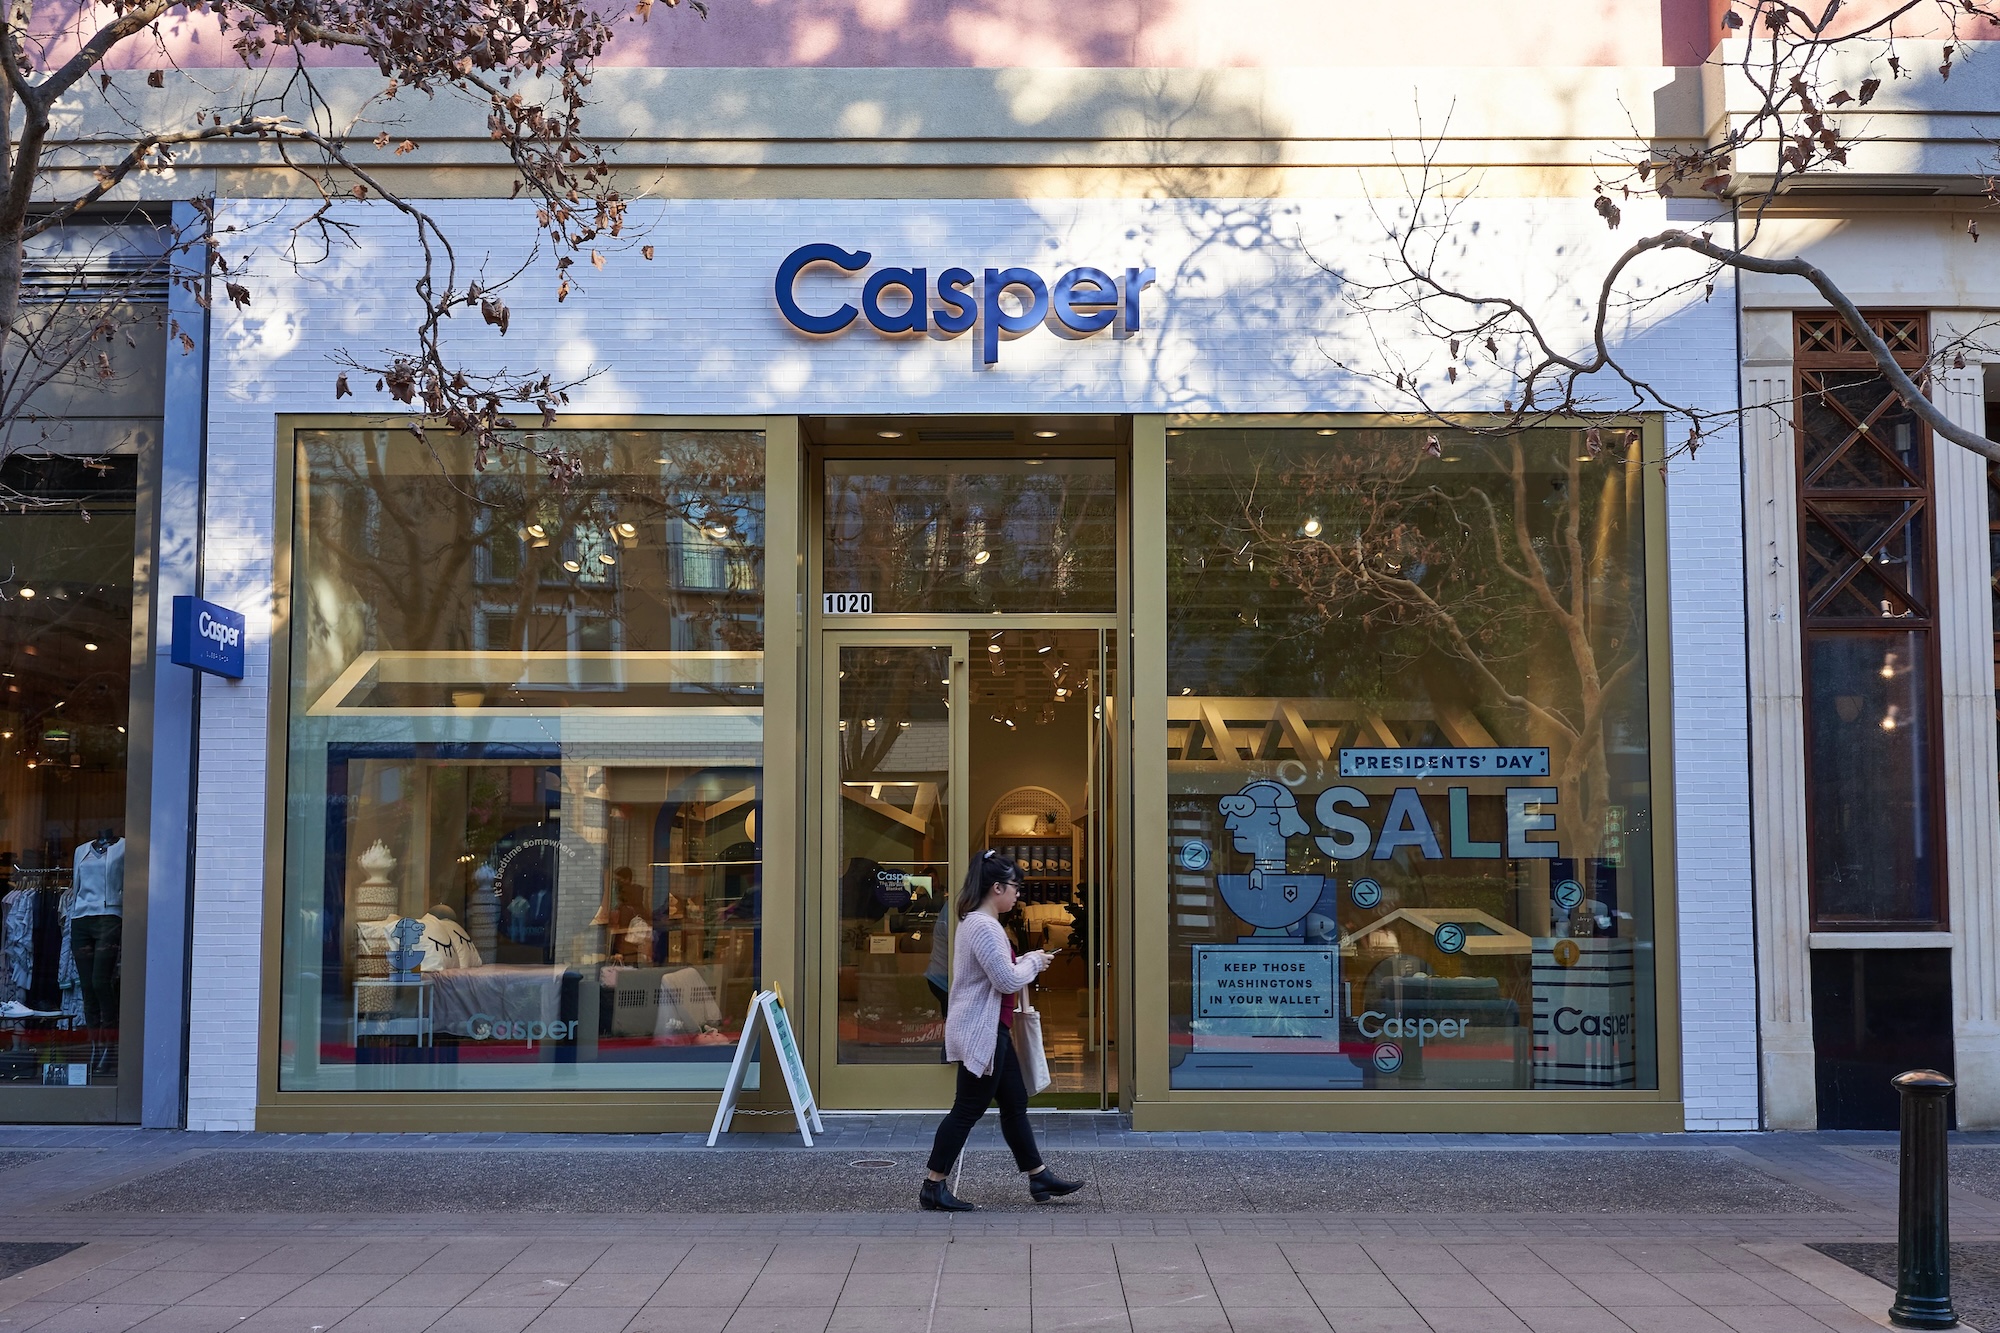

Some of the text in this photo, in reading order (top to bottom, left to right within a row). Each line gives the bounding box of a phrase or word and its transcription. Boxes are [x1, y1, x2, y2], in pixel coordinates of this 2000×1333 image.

[775, 243, 1156, 364] Casper
[826, 594, 871, 613] 1020
[199, 611, 240, 651] Casper
[1496, 755, 1534, 769] DAY
[1314, 785, 1560, 860] SALE
[494, 845, 523, 880] bedtime
[523, 838, 576, 858] somewhere
[877, 871, 914, 883] Casper
[1218, 979, 1313, 988] WASHINGTONS
[1224, 963, 1306, 972] KEEP THOSE
[1210, 996, 1321, 1004] IN YOUR WALLET
[467, 1013, 579, 1049] Casper
[1358, 1010, 1470, 1047] Casper
[1553, 1006, 1630, 1046] Casper
